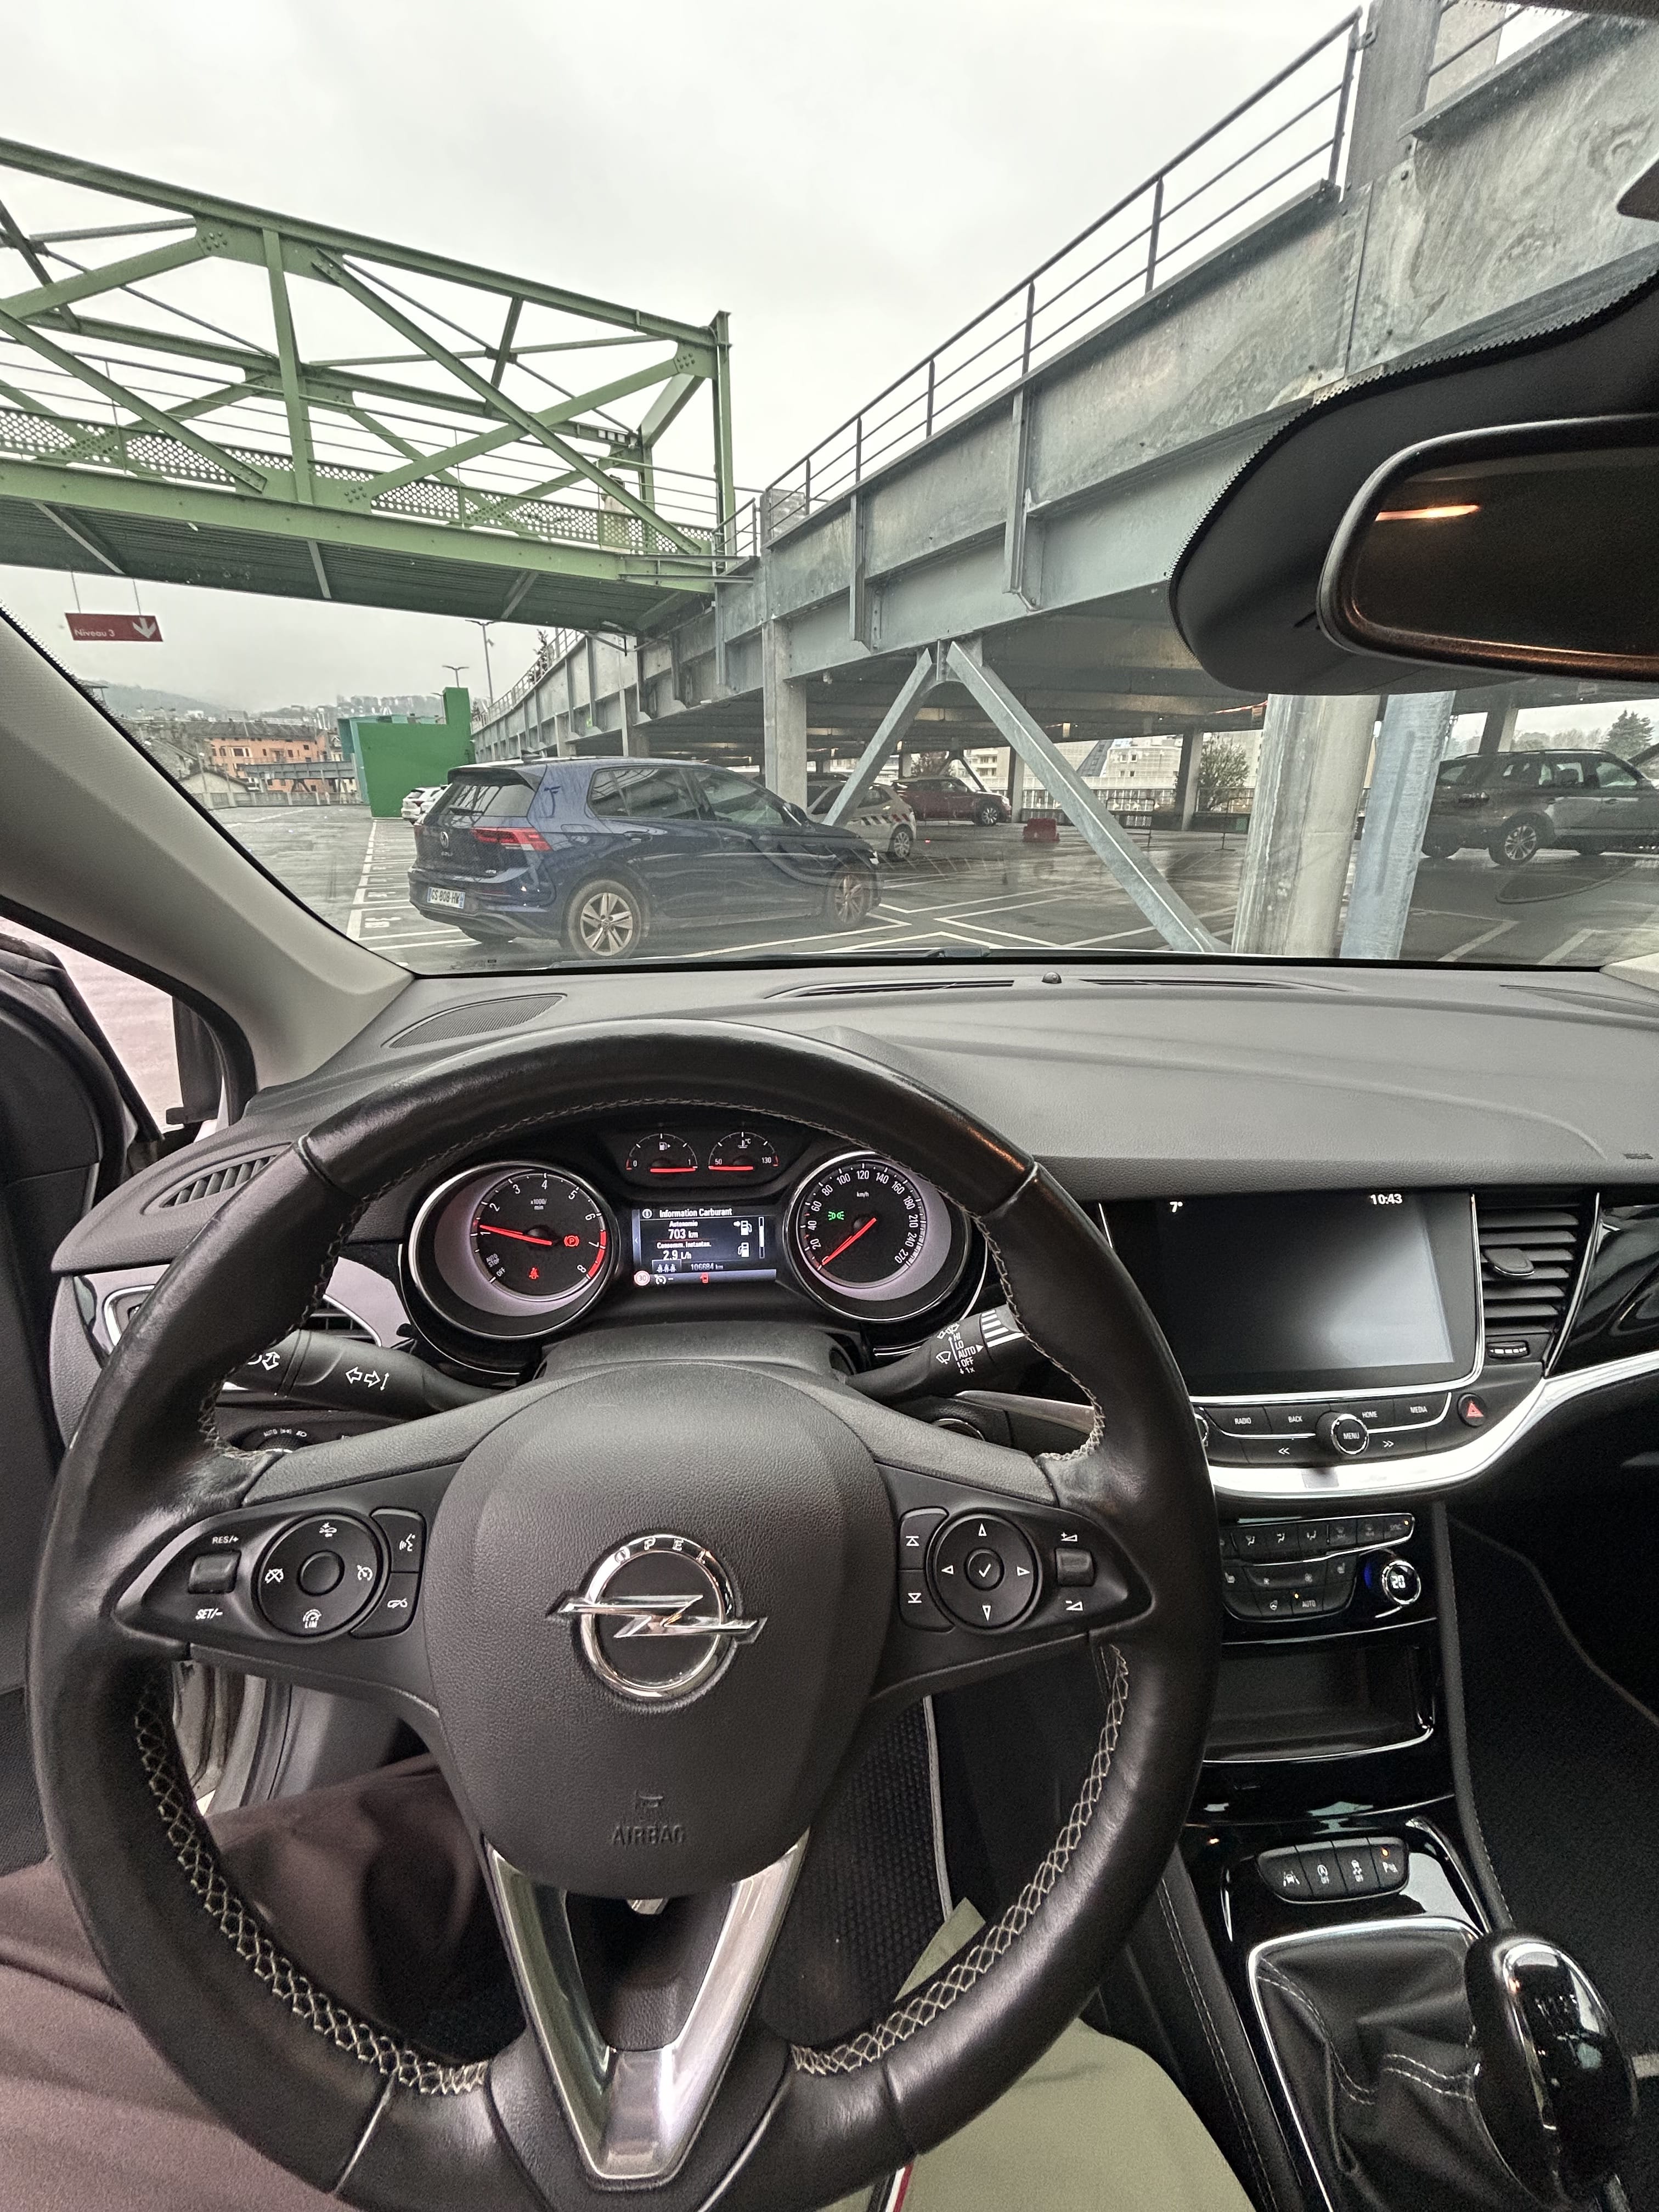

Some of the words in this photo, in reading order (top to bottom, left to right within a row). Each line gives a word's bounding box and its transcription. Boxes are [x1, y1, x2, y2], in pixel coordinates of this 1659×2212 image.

[74, 629, 107, 637] Niveau
[108, 629, 115, 637] 3
[836, 1173, 851, 1186] 100
[856, 1170, 870, 1180] 120
[876, 1172, 889, 1184] 140
[512, 1184, 521, 1194] 3
[541, 1180, 548, 1189] 4
[891, 1181, 905, 1194] 160
[568, 1190, 578, 1200] 5
[822, 1184, 833, 1197] 80
[903, 1195, 916, 1210] 180
[1370, 1193, 1403, 1206] 10:43
[489, 1203, 500, 1211] 2
[811, 1200, 822, 1212] 60
[585, 1213, 596, 1221] 6
[659, 1209, 698, 1218] Information
[698, 1208, 733, 1217] Carburant
[808, 1220, 817, 1231] 40
[909, 1214, 918, 1228] 210
[668, 1228, 686, 1240] 703
[810, 1238, 821, 1250] 20
[905, 1232, 917, 1248] 240
[486, 1253, 498, 1263] AUTO
[663, 1250, 678, 1260] 2.9
[894, 1248, 909, 1263] 270
[488, 1258, 500, 1267] STOP
[690, 1263, 714, 1271] 106684
[496, 1267, 505, 1277] OFF
[577, 1264, 587, 1273] 8
[953, 1332, 961, 1341] HI
[955, 1340, 964, 1350] LO
[958, 1346, 976, 1359] AUTO
[961, 1357, 974, 1367] OFF
[1362, 1410, 1378, 1419] HOME
[1410, 1406, 1427, 1414] MEDIA
[1234, 1417, 1251, 1425] RADIO
[1288, 1415, 1303, 1423] BACK
[1342, 1432, 1360, 1440] MENU
[212, 1535, 239, 1544] RES/+
[614, 1537, 706, 1564] OPEL
[1391, 1575, 1407, 1589] 20
[1302, 1600, 1317, 1608] AUTO
[195, 1608, 223, 1621] SET/-
[304, 1620, 318, 1628] LIM
[612, 1825, 685, 1845] AIRBAG
